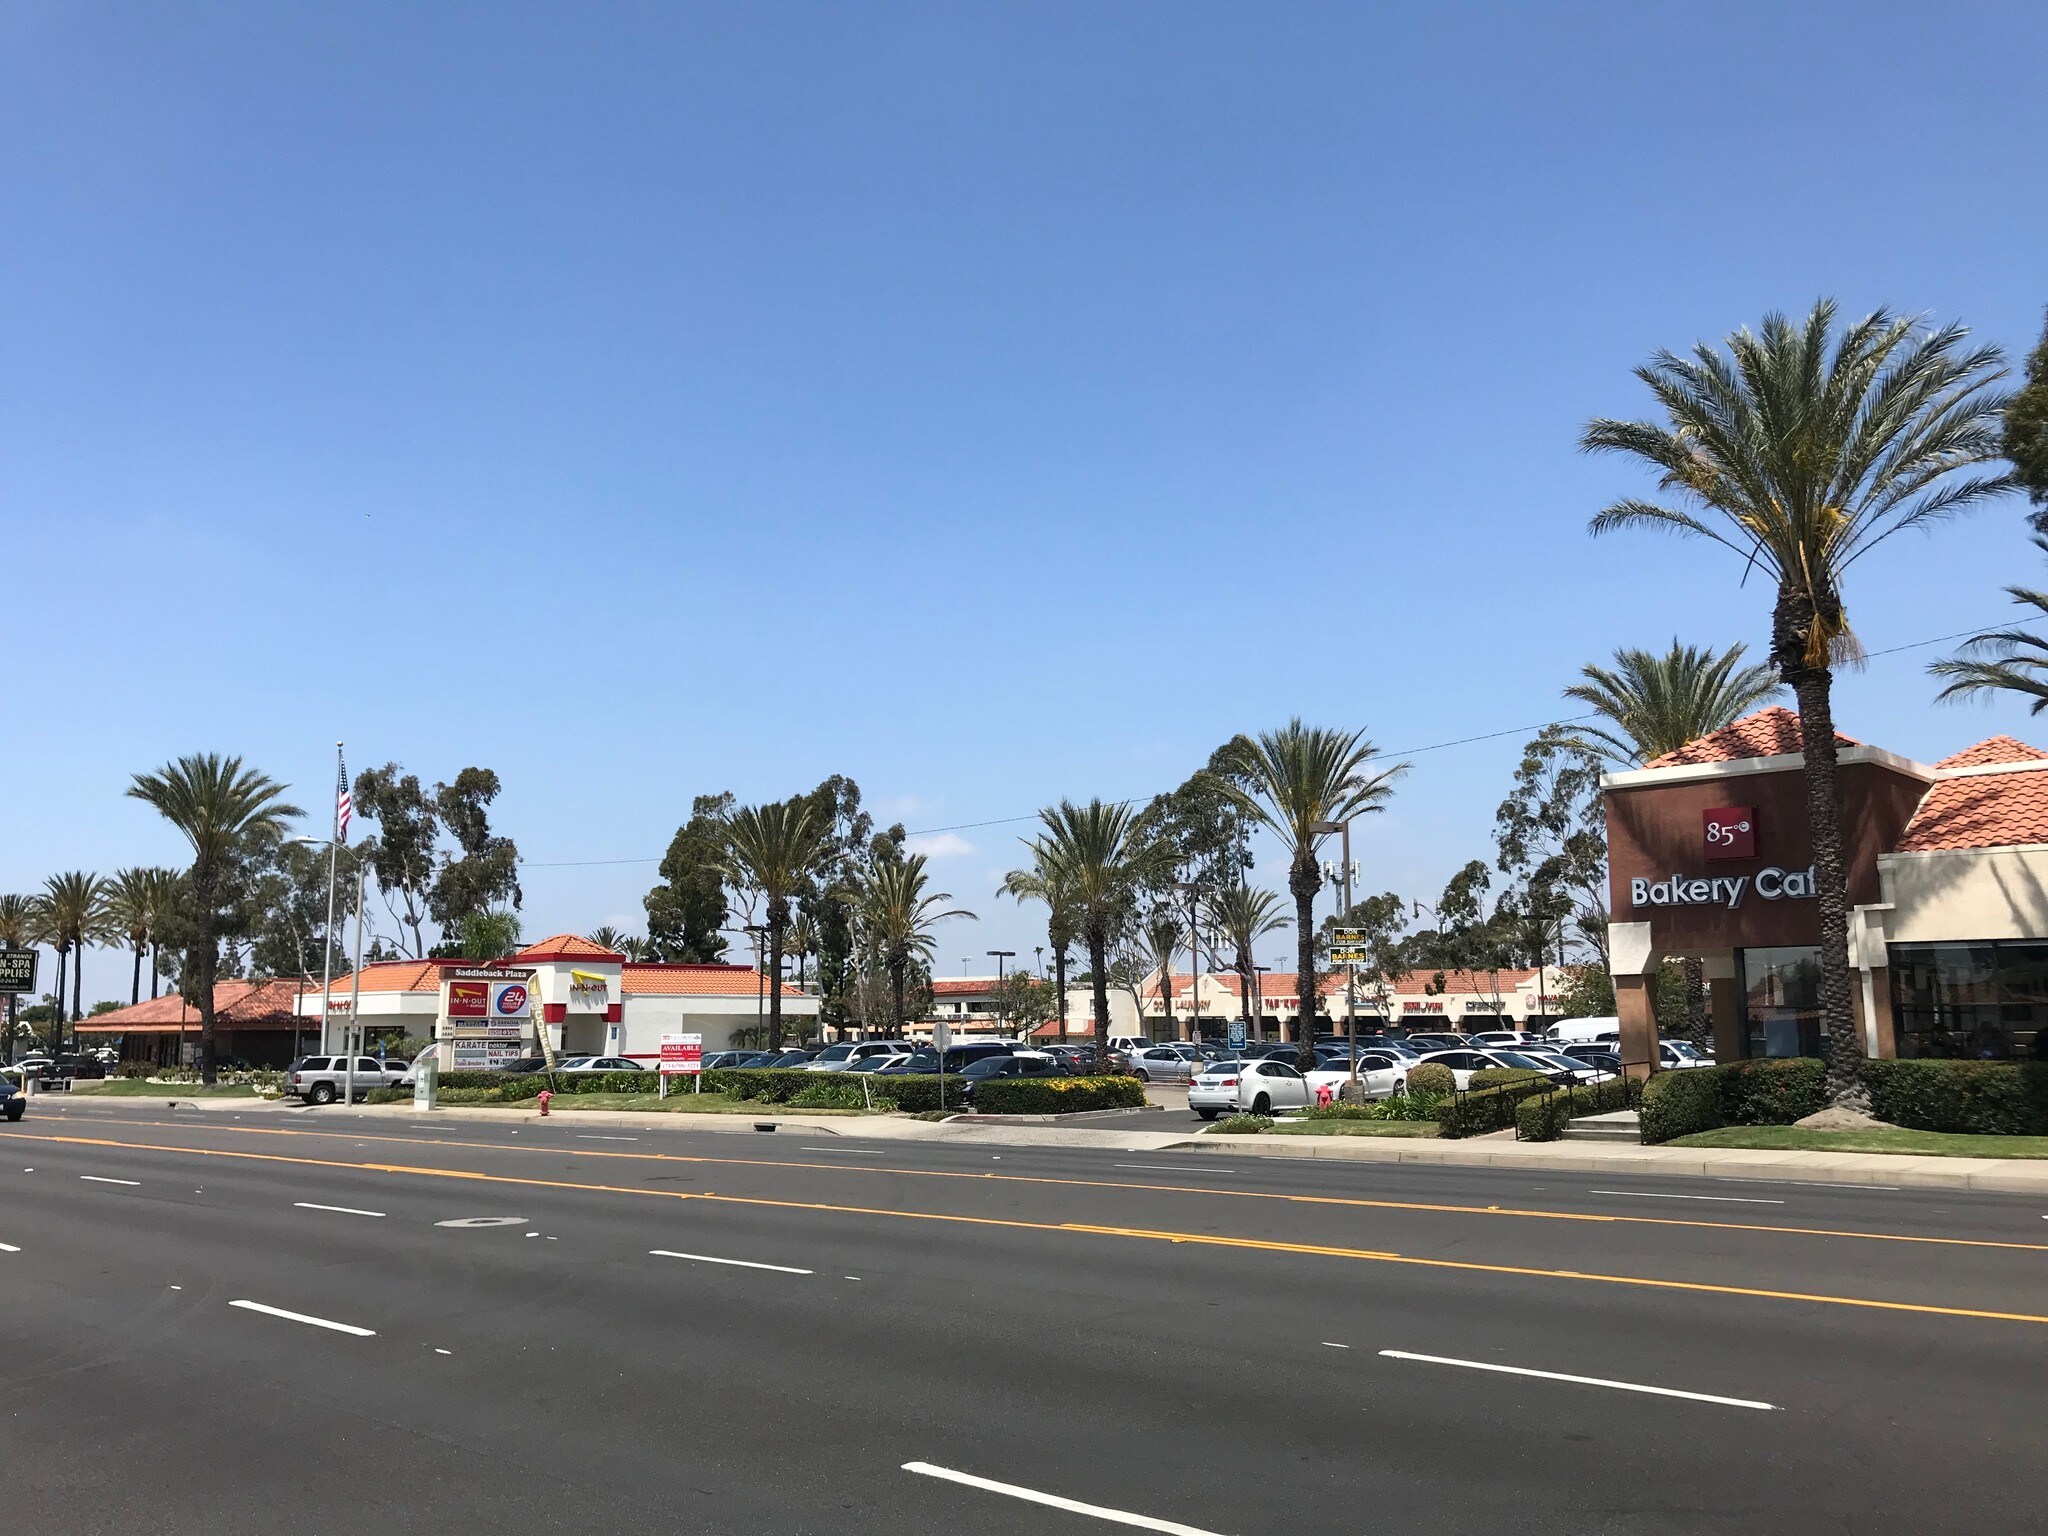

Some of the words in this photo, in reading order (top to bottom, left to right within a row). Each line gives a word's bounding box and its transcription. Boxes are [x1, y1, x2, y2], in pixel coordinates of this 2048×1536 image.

[1631, 873, 1749, 909] Bakery
[1755, 864, 1819, 900] Caf
[455, 969, 503, 977] Saddleback
[505, 969, 527, 978] Plaza
[504, 991, 525, 1006] 24
[535, 1010, 554, 1066] COFFEE
